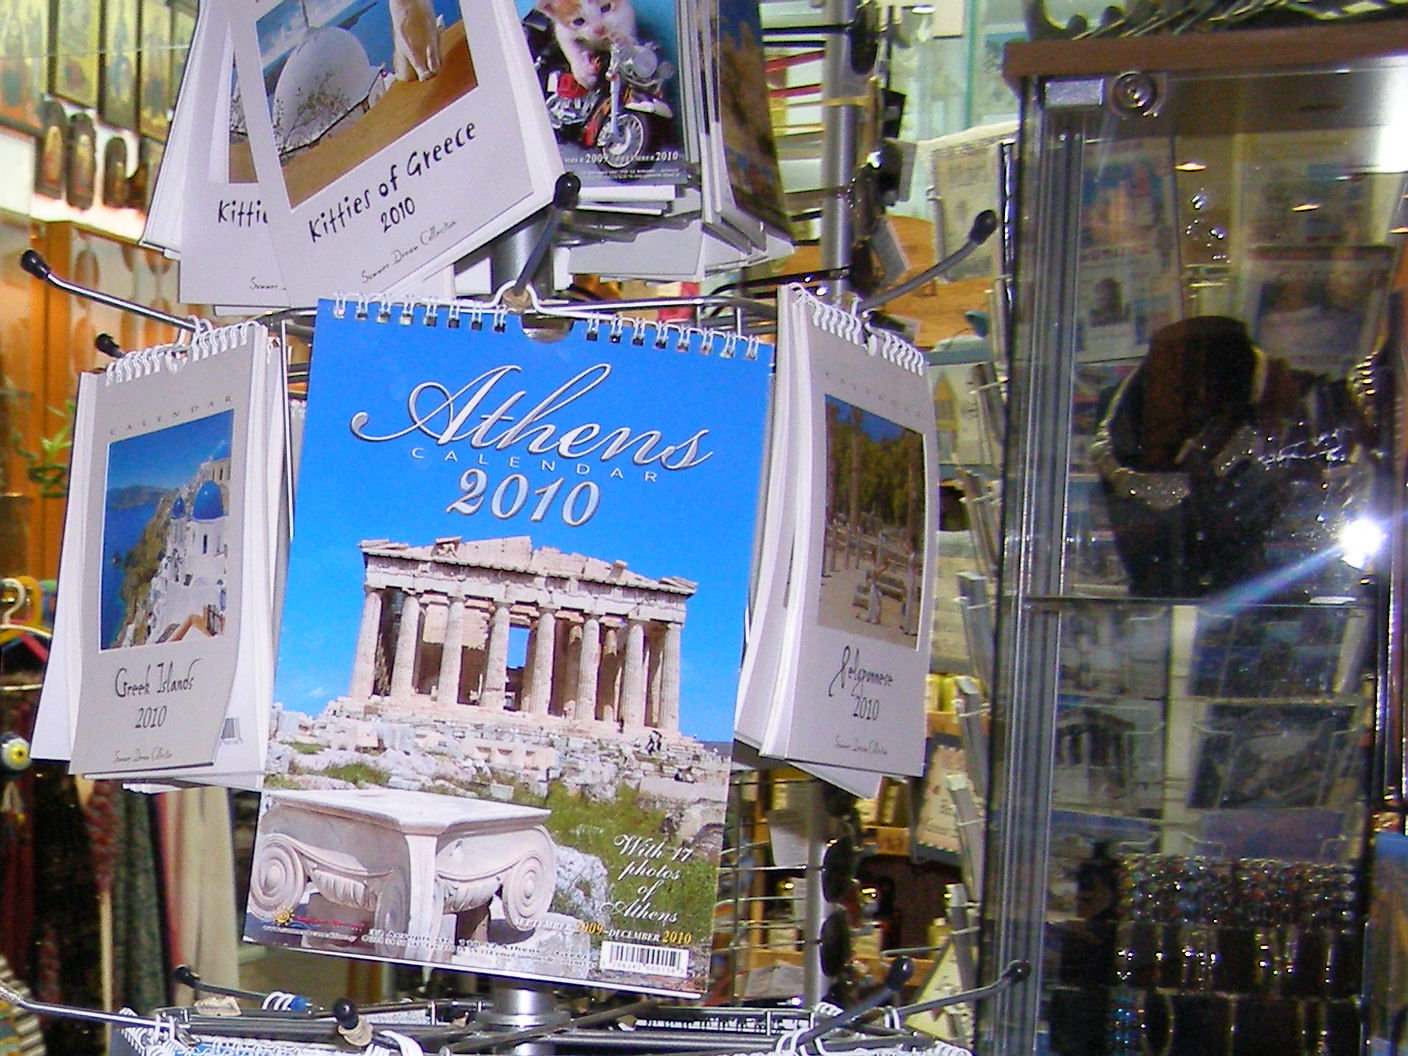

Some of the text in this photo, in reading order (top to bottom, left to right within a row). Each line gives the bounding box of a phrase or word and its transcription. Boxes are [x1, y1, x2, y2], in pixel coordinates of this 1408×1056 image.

[308, 121, 477, 243] Kitties of Greece
[380, 196, 416, 233] 2010
[350, 363, 714, 470] Athens
[411, 446, 659, 483] CALENDAR
[446, 467, 601, 527] 2010
[115, 658, 202, 698] Greek Islands
[135, 705, 168, 729] 2010
[852, 695, 880, 721] 2010
[613, 833, 693, 863] With 17
[618, 860, 681, 881] photos
[638, 880, 665, 902] of
[599, 898, 679, 928] Athens
[514, 918, 572, 932] SEPTEMBER
[662, 929, 692, 945] 2010
